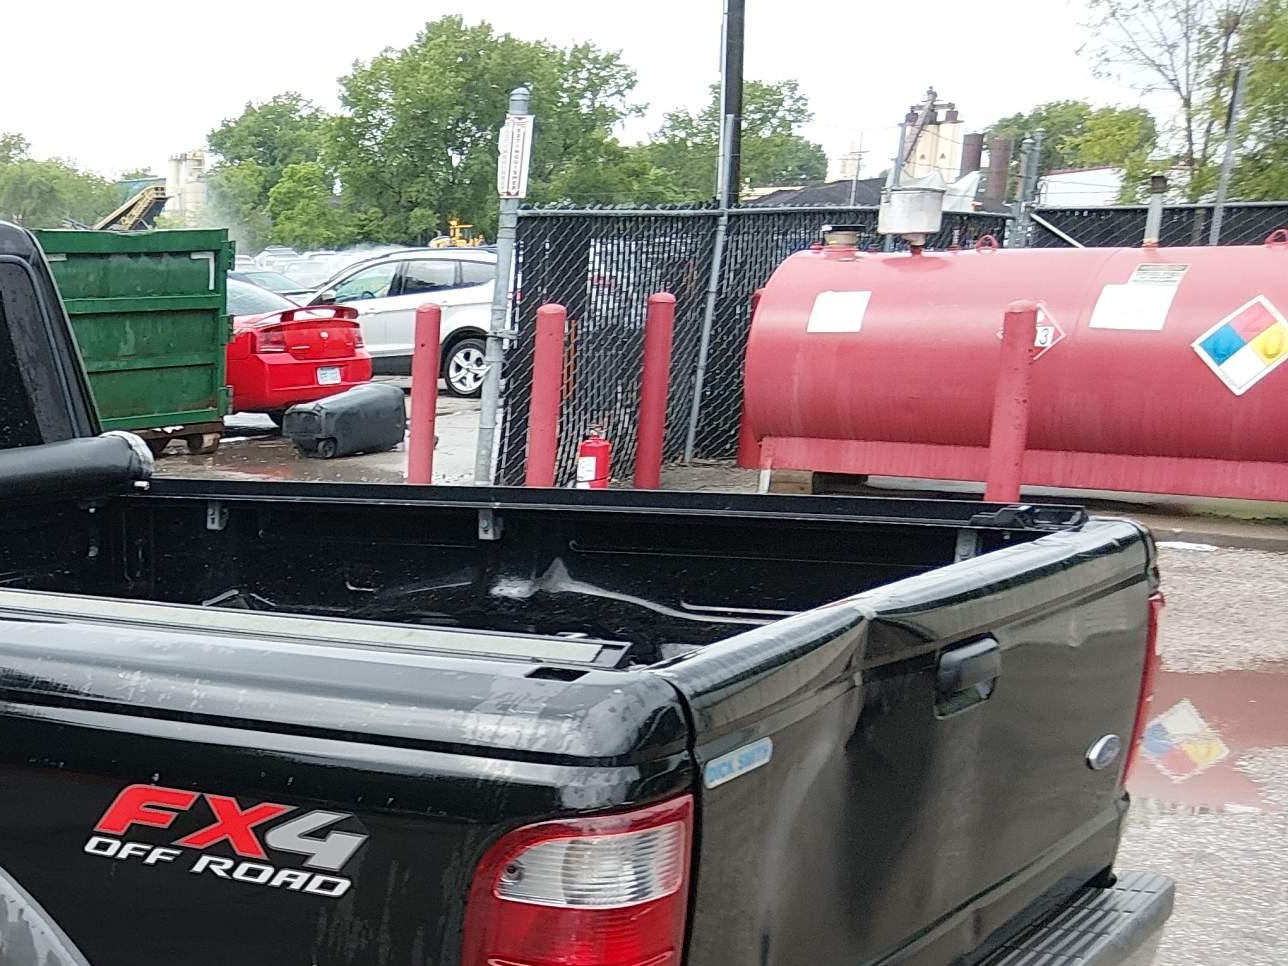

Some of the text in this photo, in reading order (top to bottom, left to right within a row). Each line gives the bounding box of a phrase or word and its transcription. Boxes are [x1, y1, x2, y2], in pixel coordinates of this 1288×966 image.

[92, 783, 370, 872] FX4
[83, 835, 352, 898] OFF ROAD
